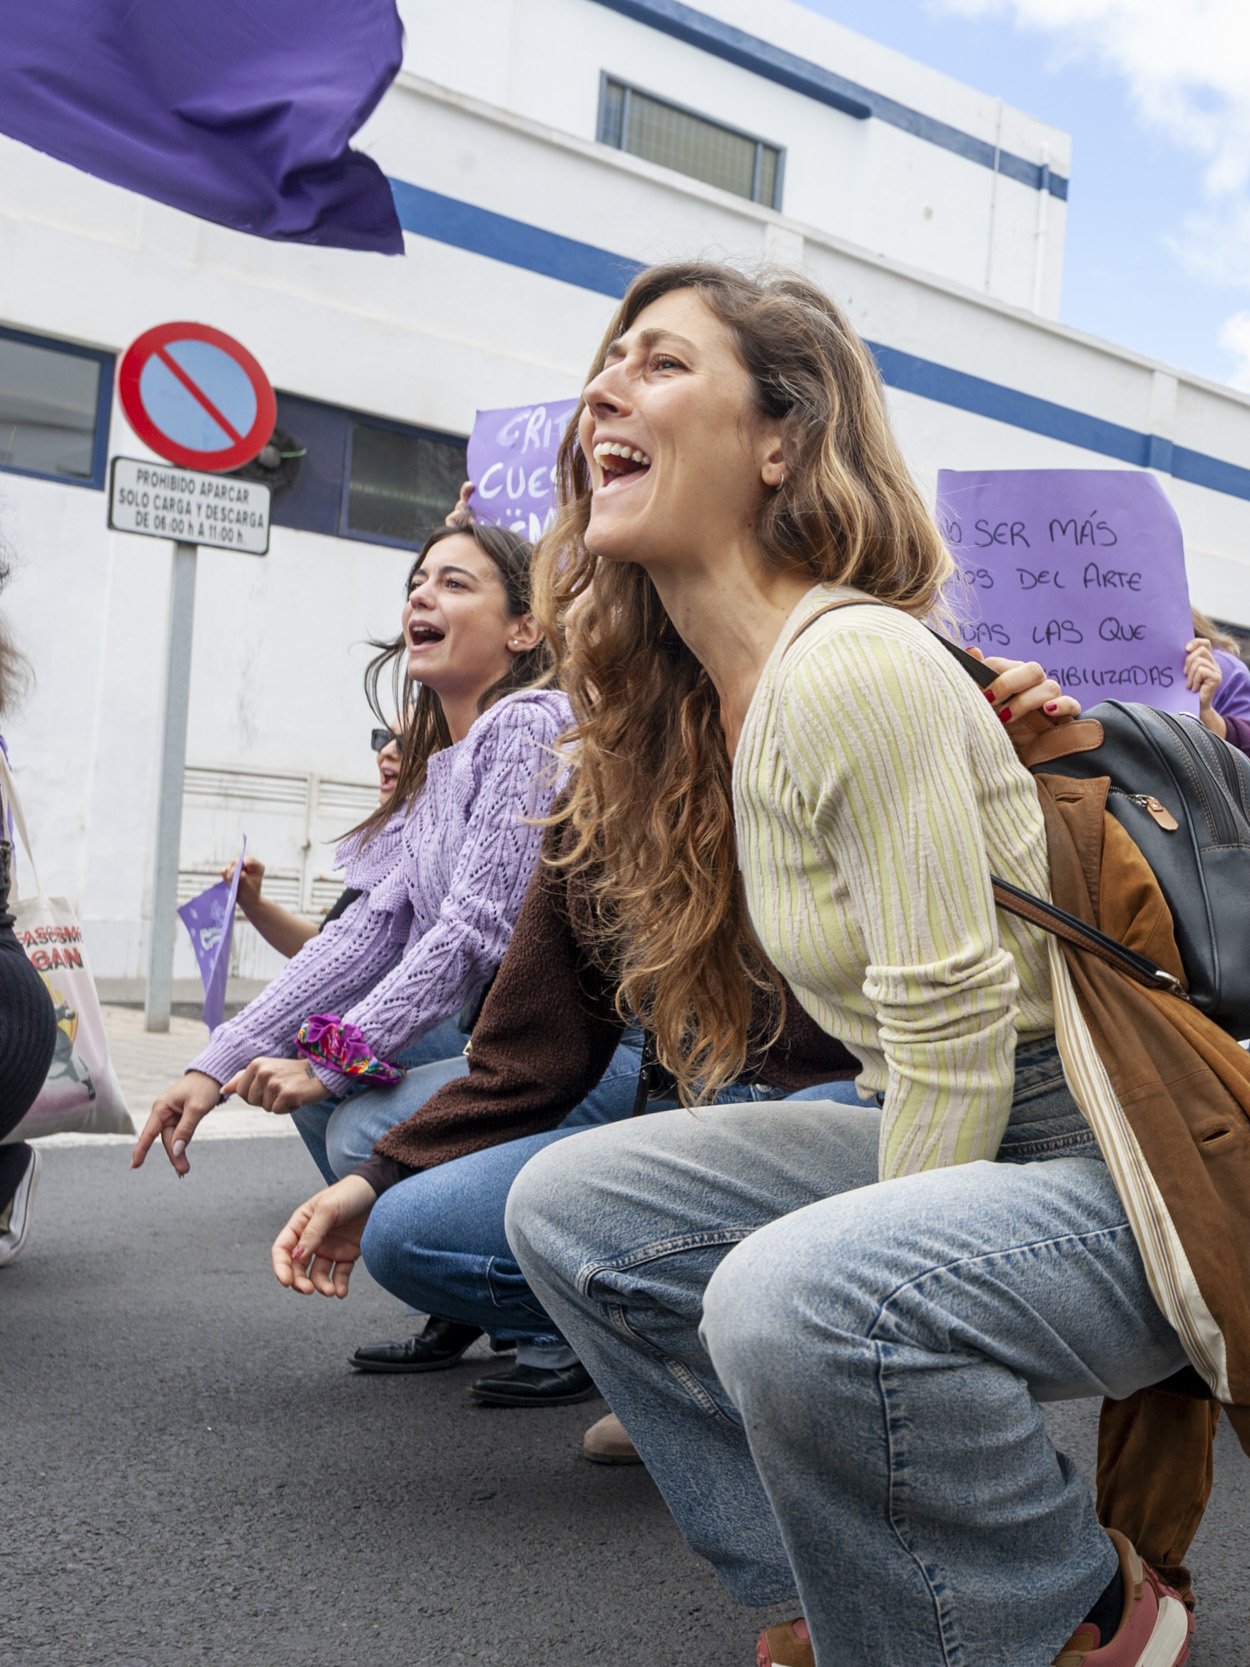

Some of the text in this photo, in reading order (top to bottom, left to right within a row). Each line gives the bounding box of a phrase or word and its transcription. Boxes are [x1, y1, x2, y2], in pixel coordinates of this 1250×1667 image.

[136, 468, 250, 505] PROHIBIDO APARCAR
[119, 488, 265, 529] SOLO CARGA Y DESCARGA
[135, 511, 150, 529] DE
[198, 522, 206, 537] A
[974, 518, 1031, 548] SER
[1049, 509, 1118, 546] MÁS
[956, 566, 994, 590] OS
[1016, 567, 1066, 590] DEL
[948, 616, 1148, 646] DAS LAS QUE
[1043, 665, 1175, 689] SIBILIZADAS
